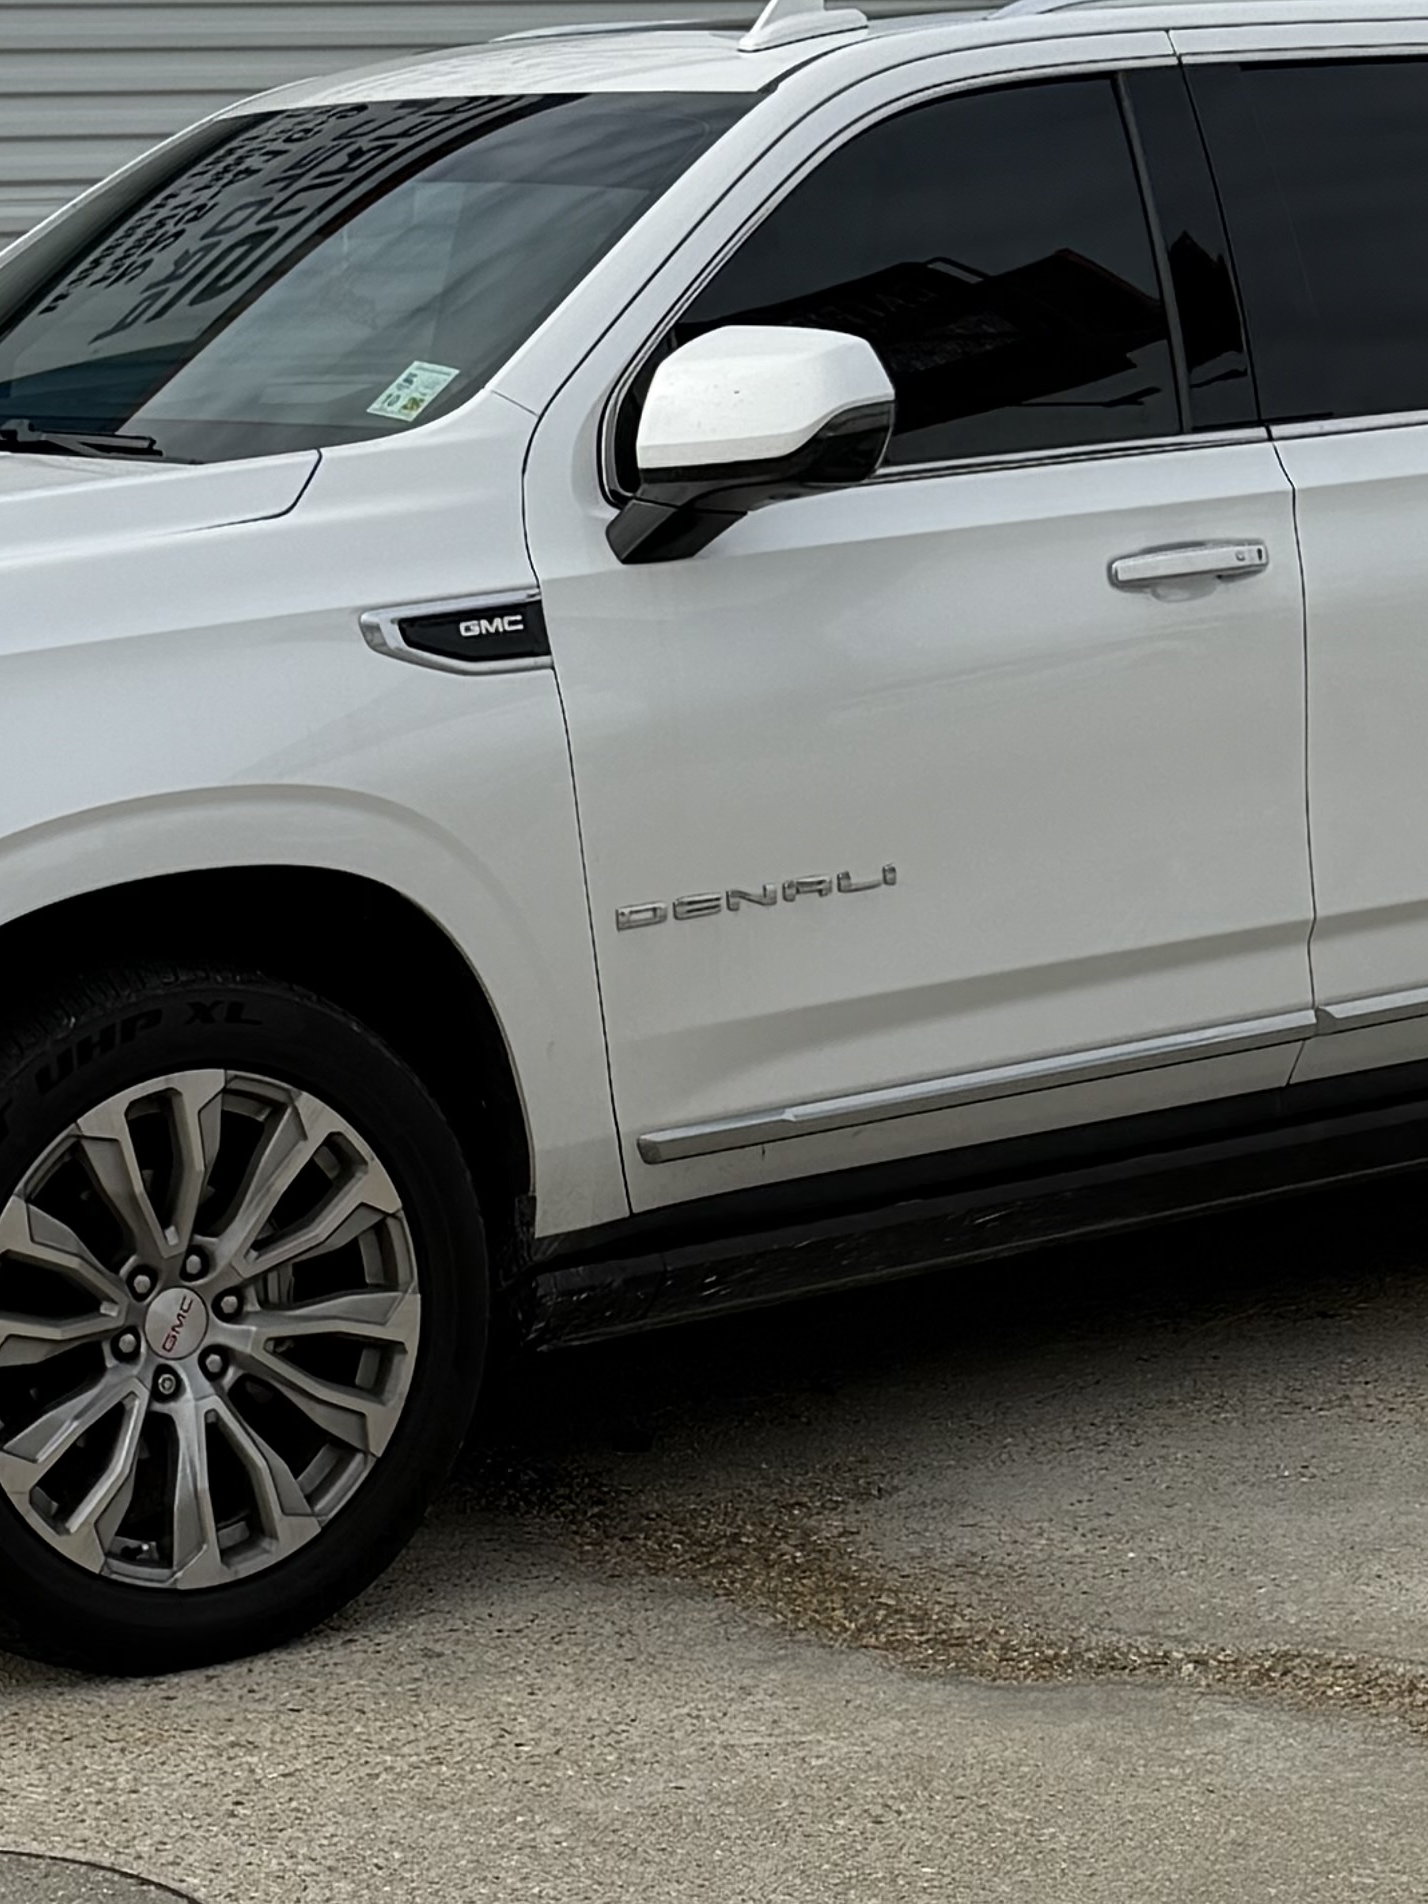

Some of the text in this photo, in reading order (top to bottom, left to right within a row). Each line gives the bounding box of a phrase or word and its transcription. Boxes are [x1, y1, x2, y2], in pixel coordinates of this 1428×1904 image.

[459, 614, 524, 637] GMC
[615, 863, 897, 932] DENALI
[34, 1007, 164, 1097] UHP
[183, 999, 264, 1027] XL
[162, 1295, 193, 1352] GMC
